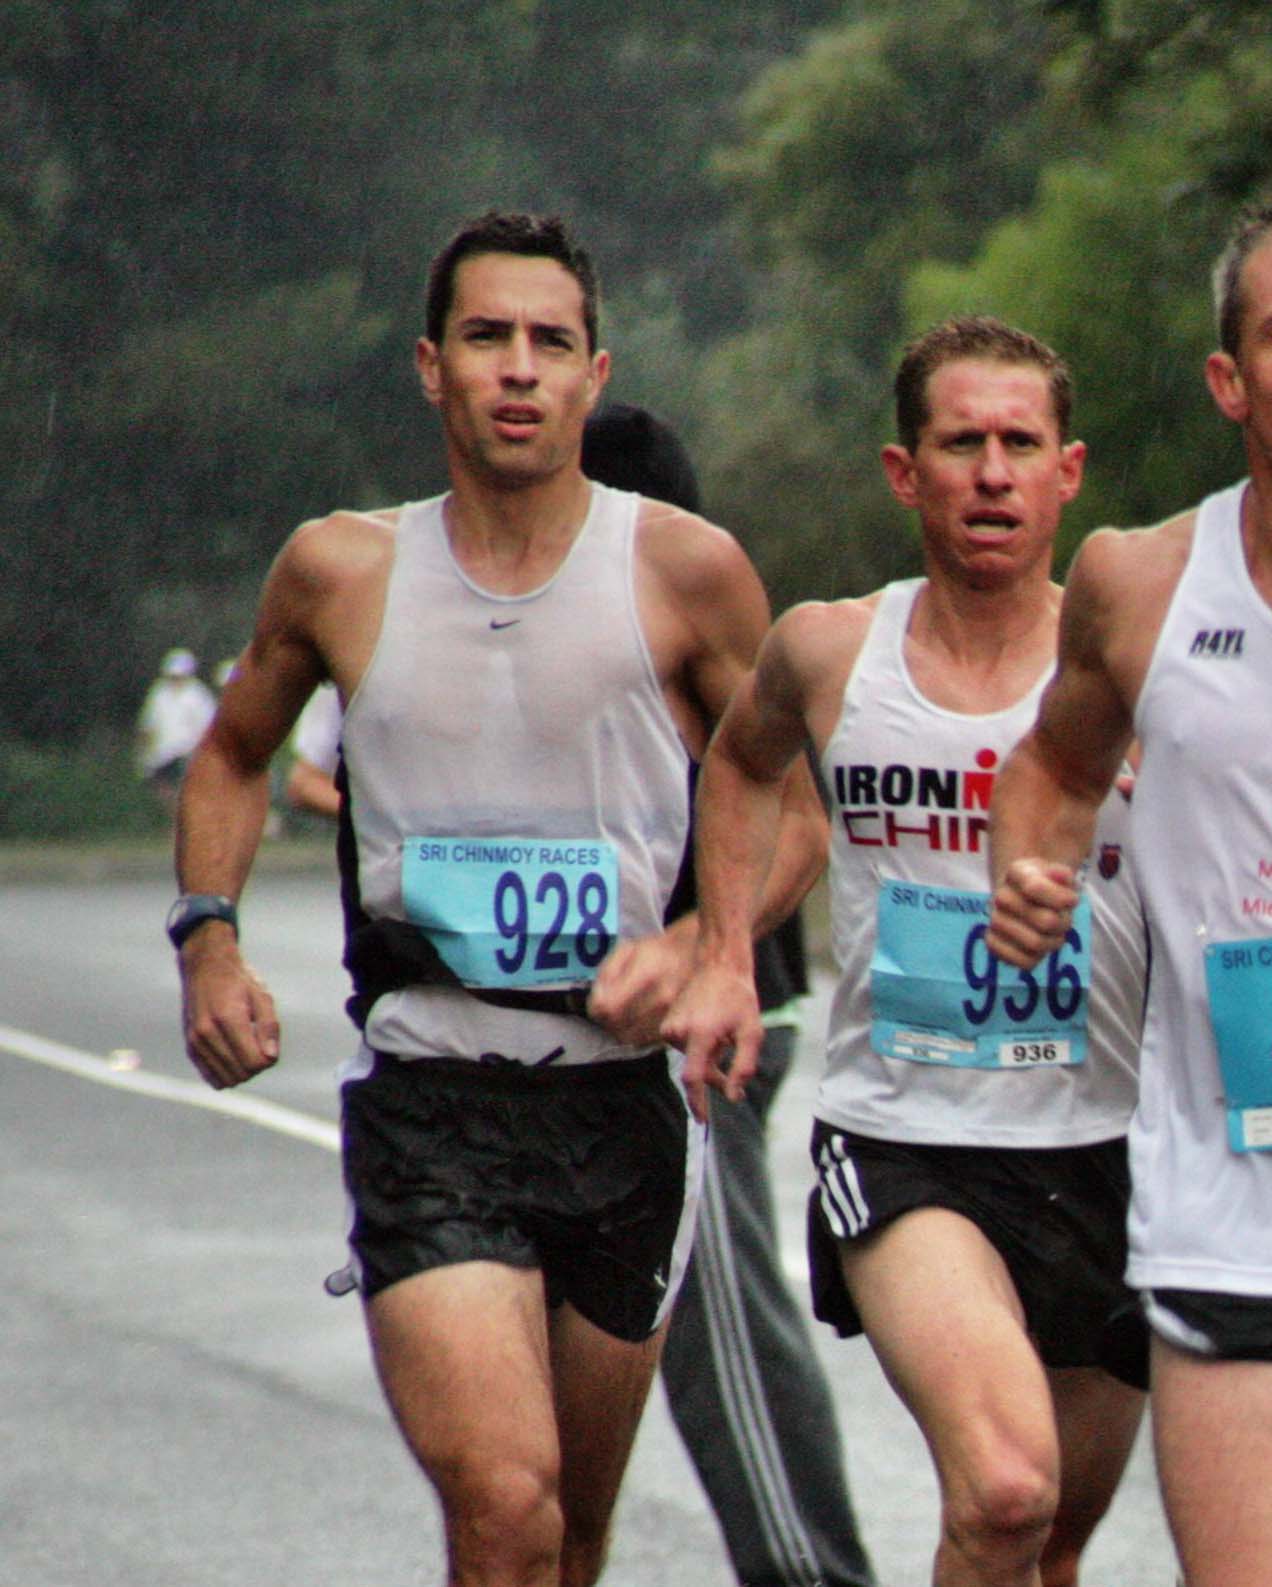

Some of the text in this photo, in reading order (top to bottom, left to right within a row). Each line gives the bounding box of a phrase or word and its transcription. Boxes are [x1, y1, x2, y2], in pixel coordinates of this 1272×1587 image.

[834, 748, 998, 810] IRONM
[419, 844, 600, 865] SRI CHINMOY RACES
[923, 892, 990, 917] CHINM
[493, 870, 611, 974] 928
[1221, 949, 1254, 970] SRI
[1012, 1043, 1057, 1062] 936
